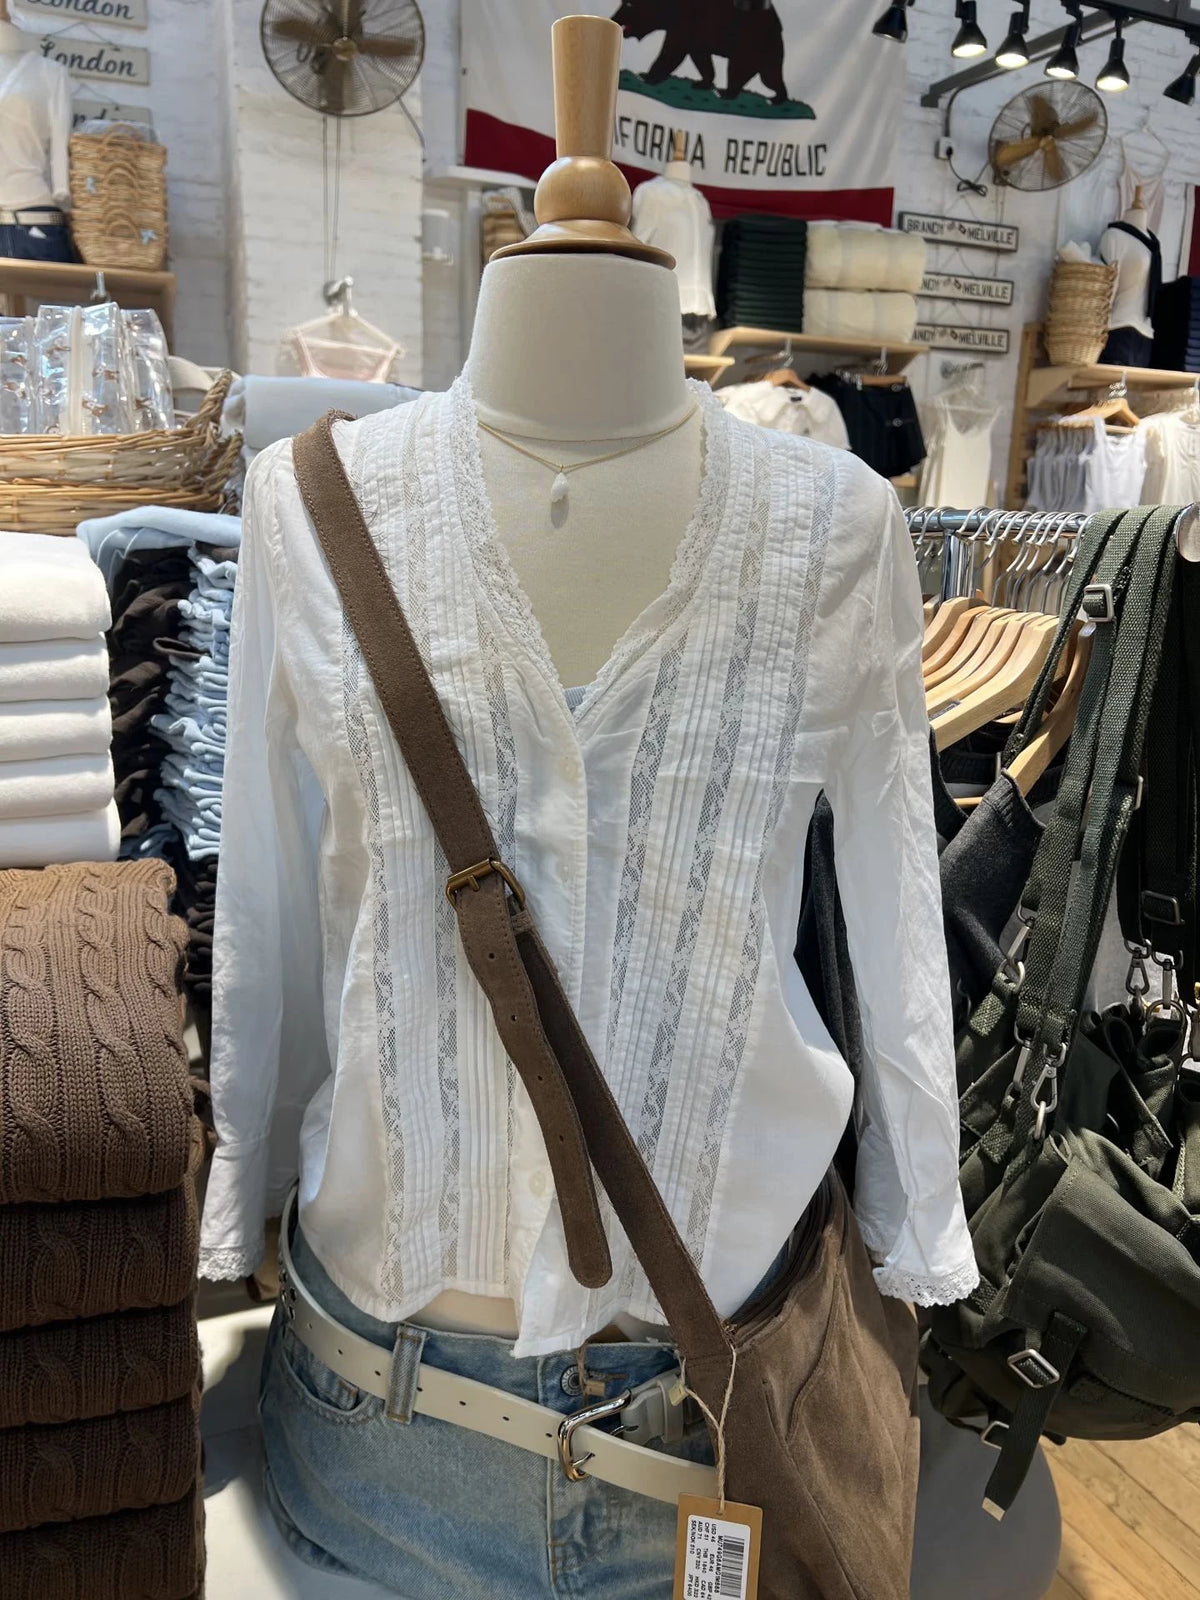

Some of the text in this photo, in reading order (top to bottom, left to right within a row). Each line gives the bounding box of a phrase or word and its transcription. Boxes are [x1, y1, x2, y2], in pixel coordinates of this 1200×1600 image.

[27, 0, 134, 19] ondon
[613, 116, 827, 177] IFORNIA REPUBLIC
[906, 219, 1013, 245] BRANDY MELVILLE
[963, 282, 1008, 299] MELVILLE
[913, 328, 1004, 347] ANDY MELVILLE
